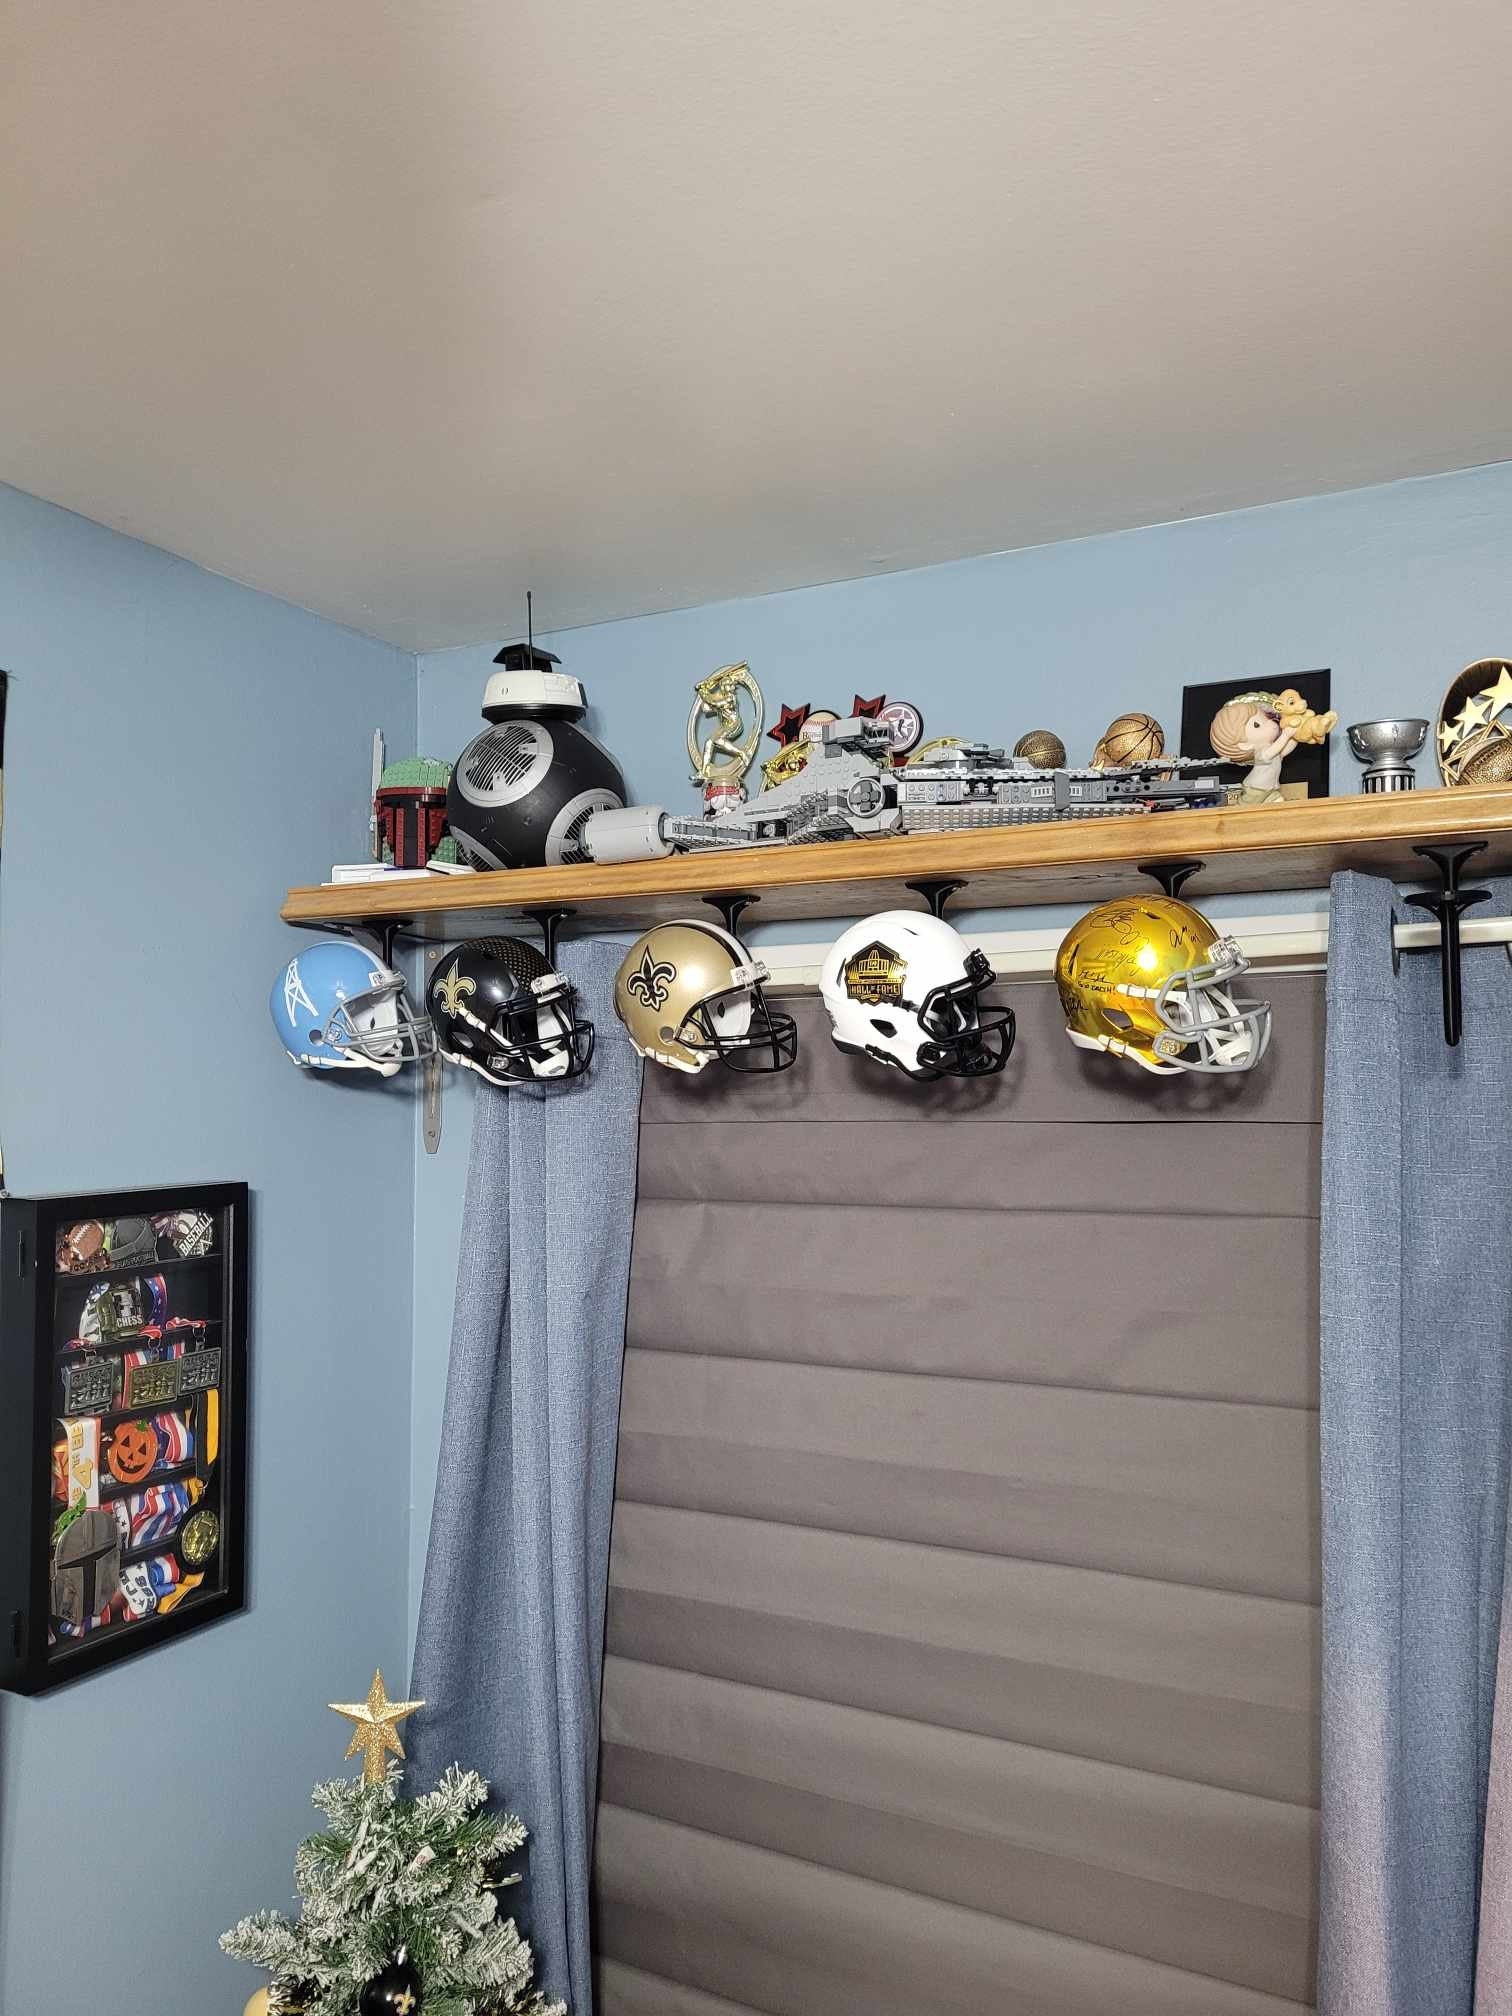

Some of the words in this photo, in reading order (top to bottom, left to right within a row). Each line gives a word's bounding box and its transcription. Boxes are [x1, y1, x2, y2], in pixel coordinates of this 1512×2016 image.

[852, 984, 871, 994] HALL
[877, 984, 899, 994] FAME
[178, 1212, 214, 1256] BASEBALL
[116, 1314, 143, 1328] CHESS
